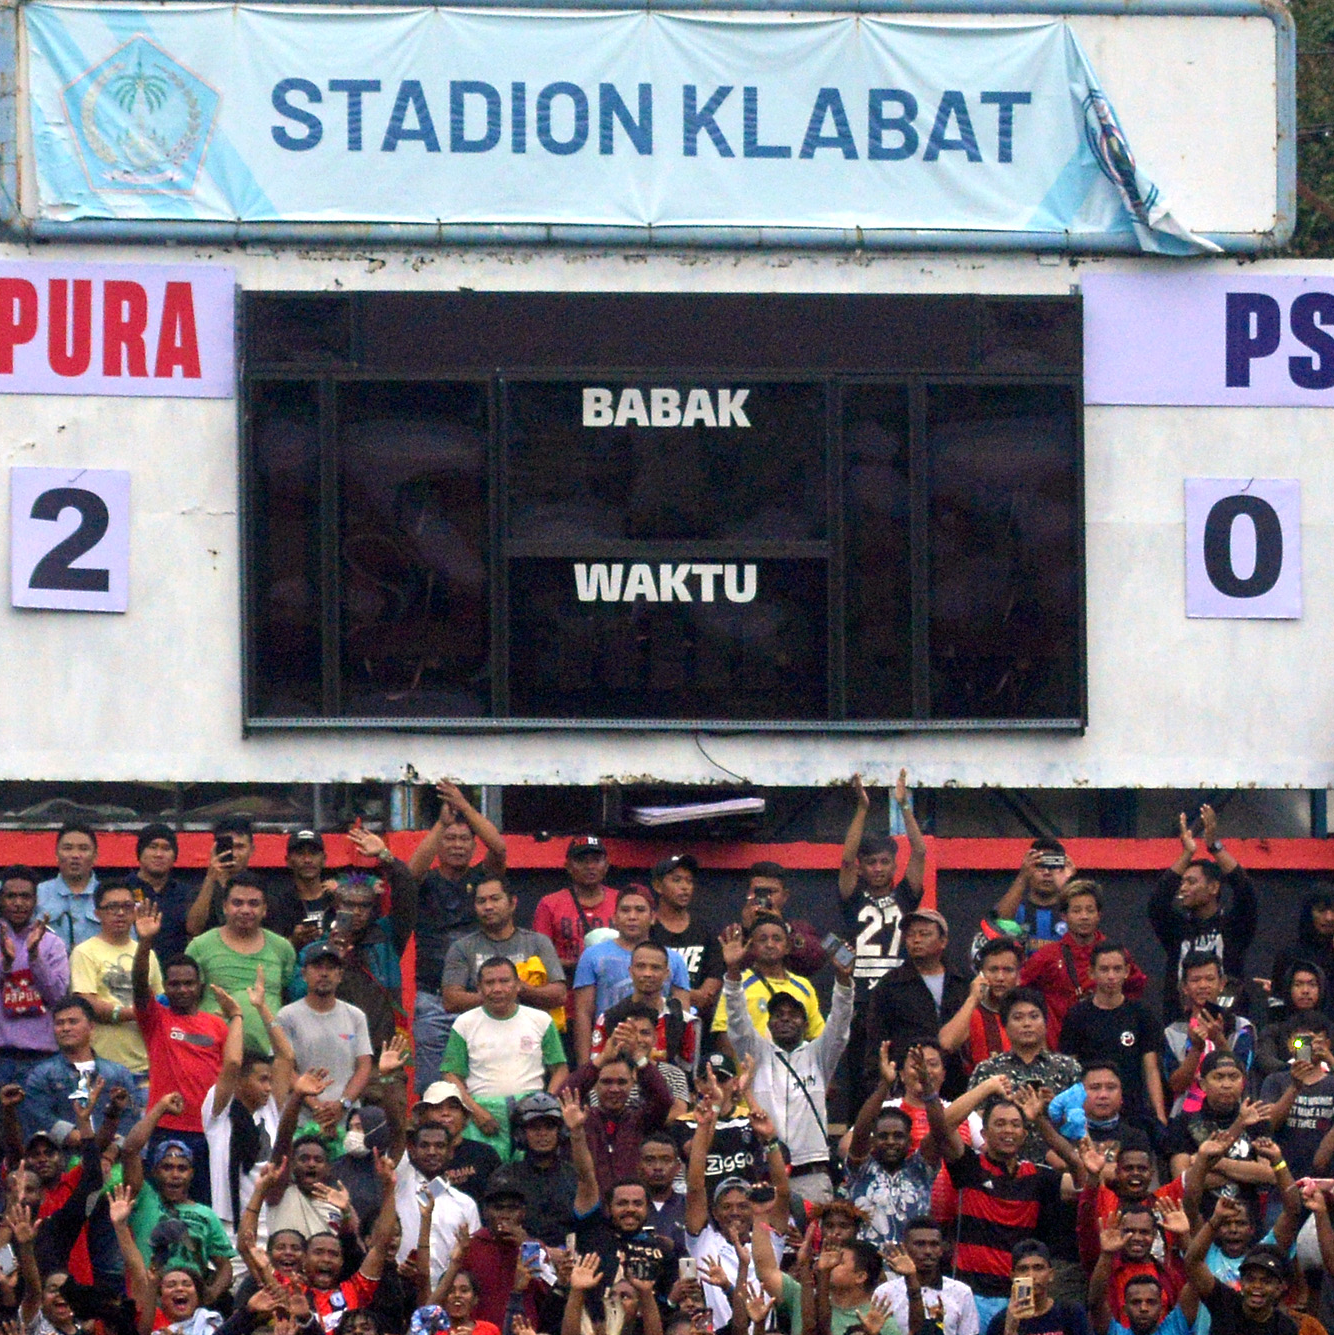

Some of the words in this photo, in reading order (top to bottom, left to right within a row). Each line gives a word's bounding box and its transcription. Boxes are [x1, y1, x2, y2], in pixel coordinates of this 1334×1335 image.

[269, 77, 654, 157] STADION
[681, 84, 1032, 164] KLABAT
[582, 387, 752, 428] BABAK
[27, 486, 111, 593] 2
[1201, 493, 1284, 600] 0
[573, 563, 758, 604] WAKTU
[855, 904, 903, 957] 27
[704, 1151, 755, 1177] ZIGGO
